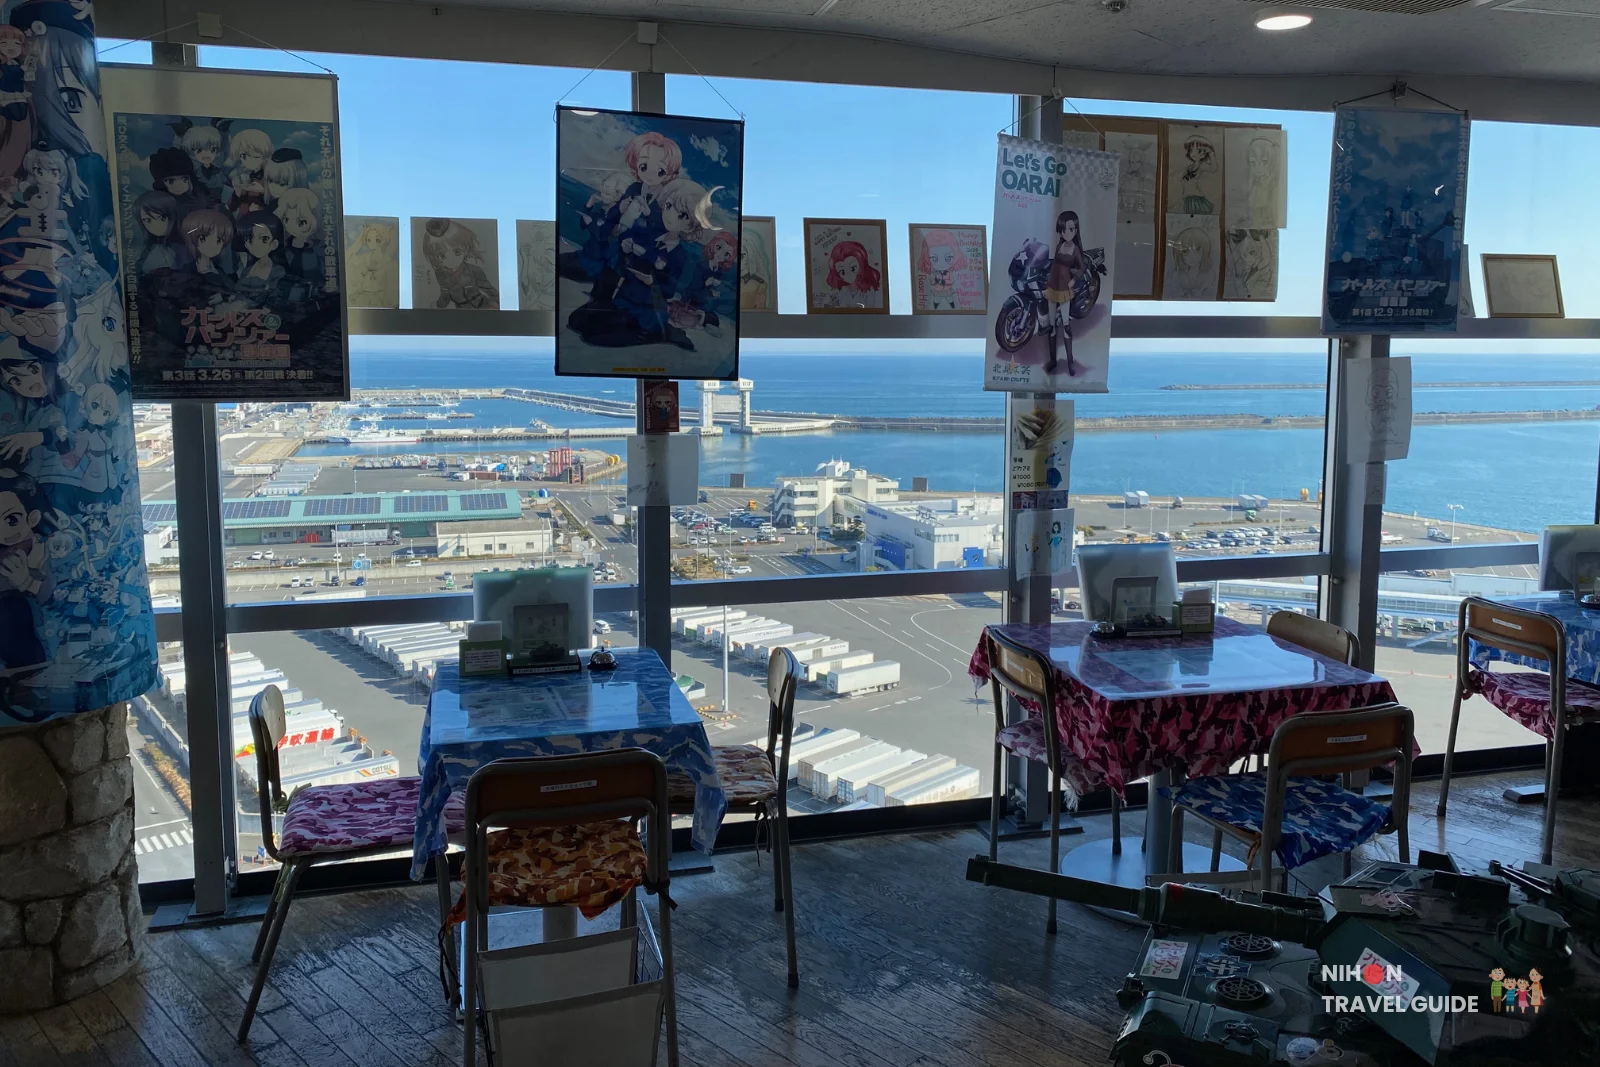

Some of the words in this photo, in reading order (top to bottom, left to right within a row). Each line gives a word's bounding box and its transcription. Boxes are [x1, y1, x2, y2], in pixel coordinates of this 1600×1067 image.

[1002, 147, 1041, 172] Let's
[1044, 156, 1068, 176] Go
[1001, 169, 1060, 198] OARAI
[197, 368, 232, 381] 3.26
